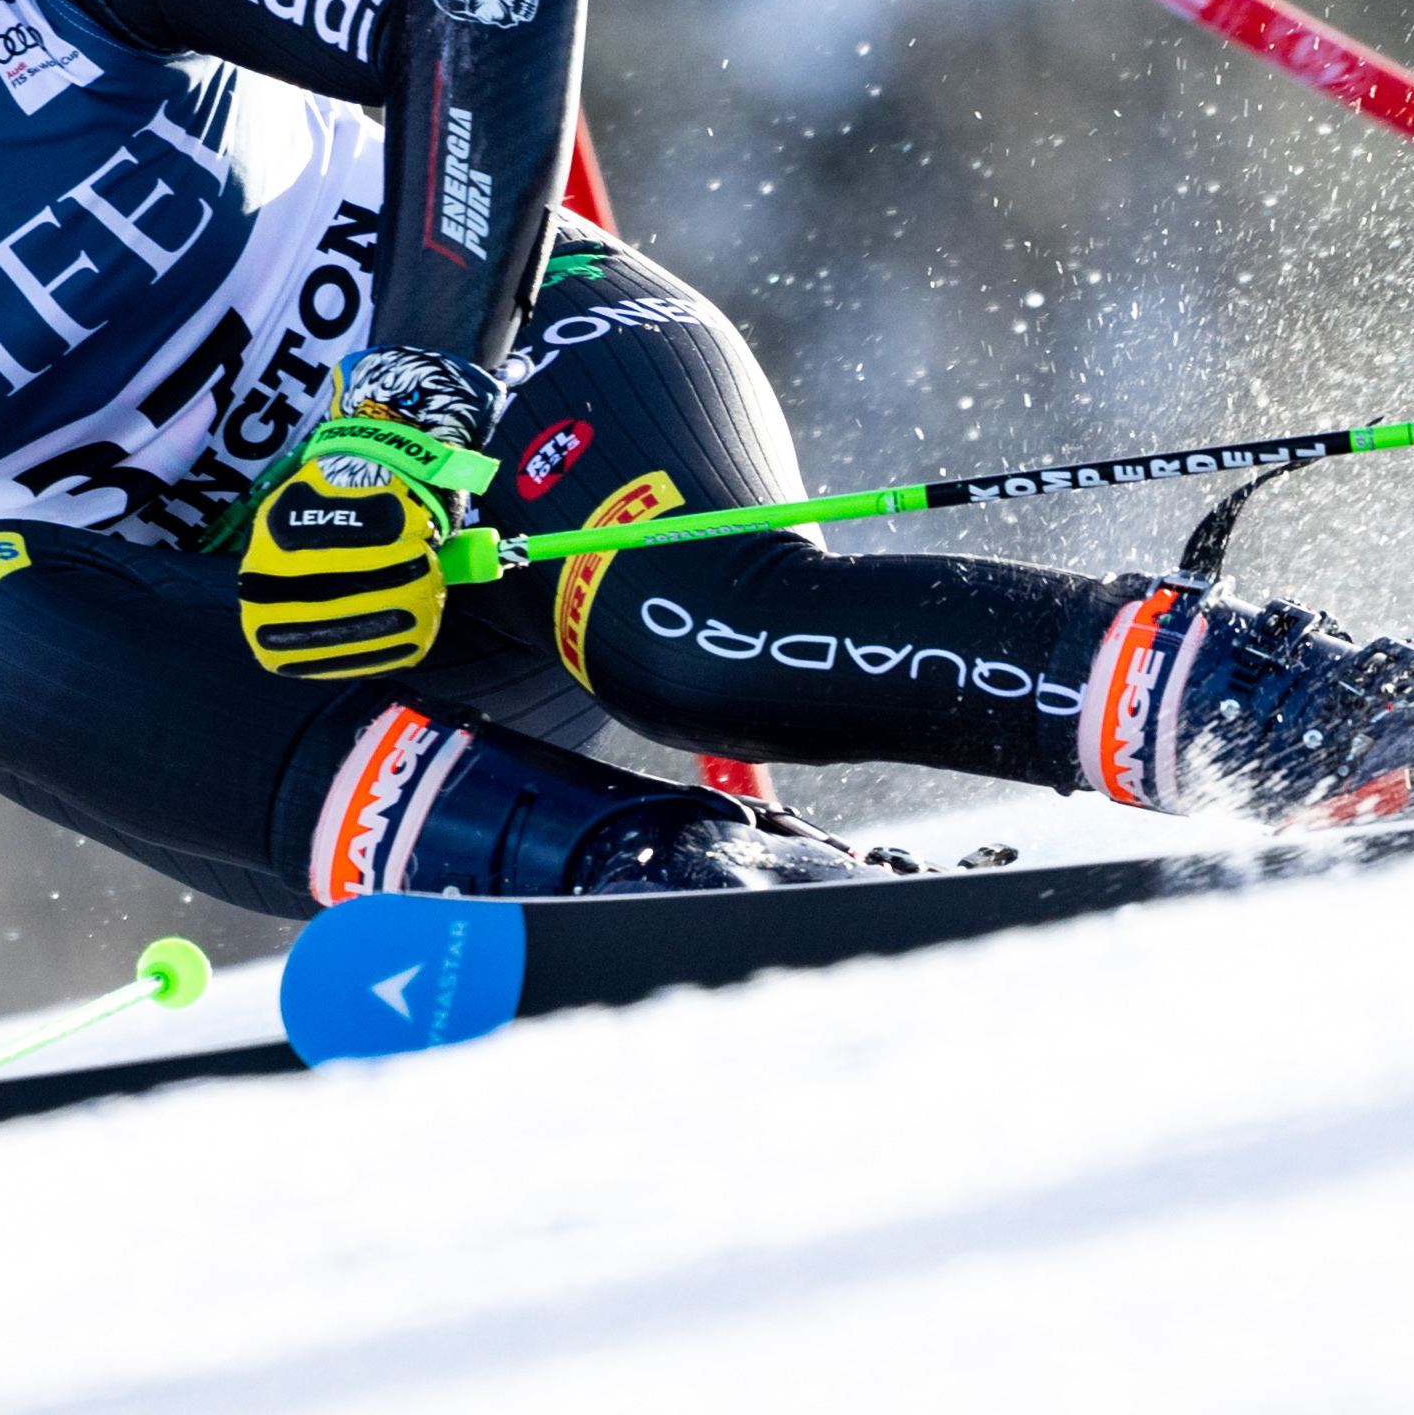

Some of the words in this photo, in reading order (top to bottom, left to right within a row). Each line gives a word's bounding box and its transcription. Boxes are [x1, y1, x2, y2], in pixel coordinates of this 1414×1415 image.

[10, 74, 28, 89] FIS
[60, 49, 80, 66] Cup
[526, 432, 576, 476] RTL
[968, 442, 1327, 503] KOMPERDELL
[289, 510, 364, 527] LEVEL
[560, 484, 660, 674] PIRELI
[1111, 646, 1167, 806] ANGE
[344, 722, 439, 896] LANGE
